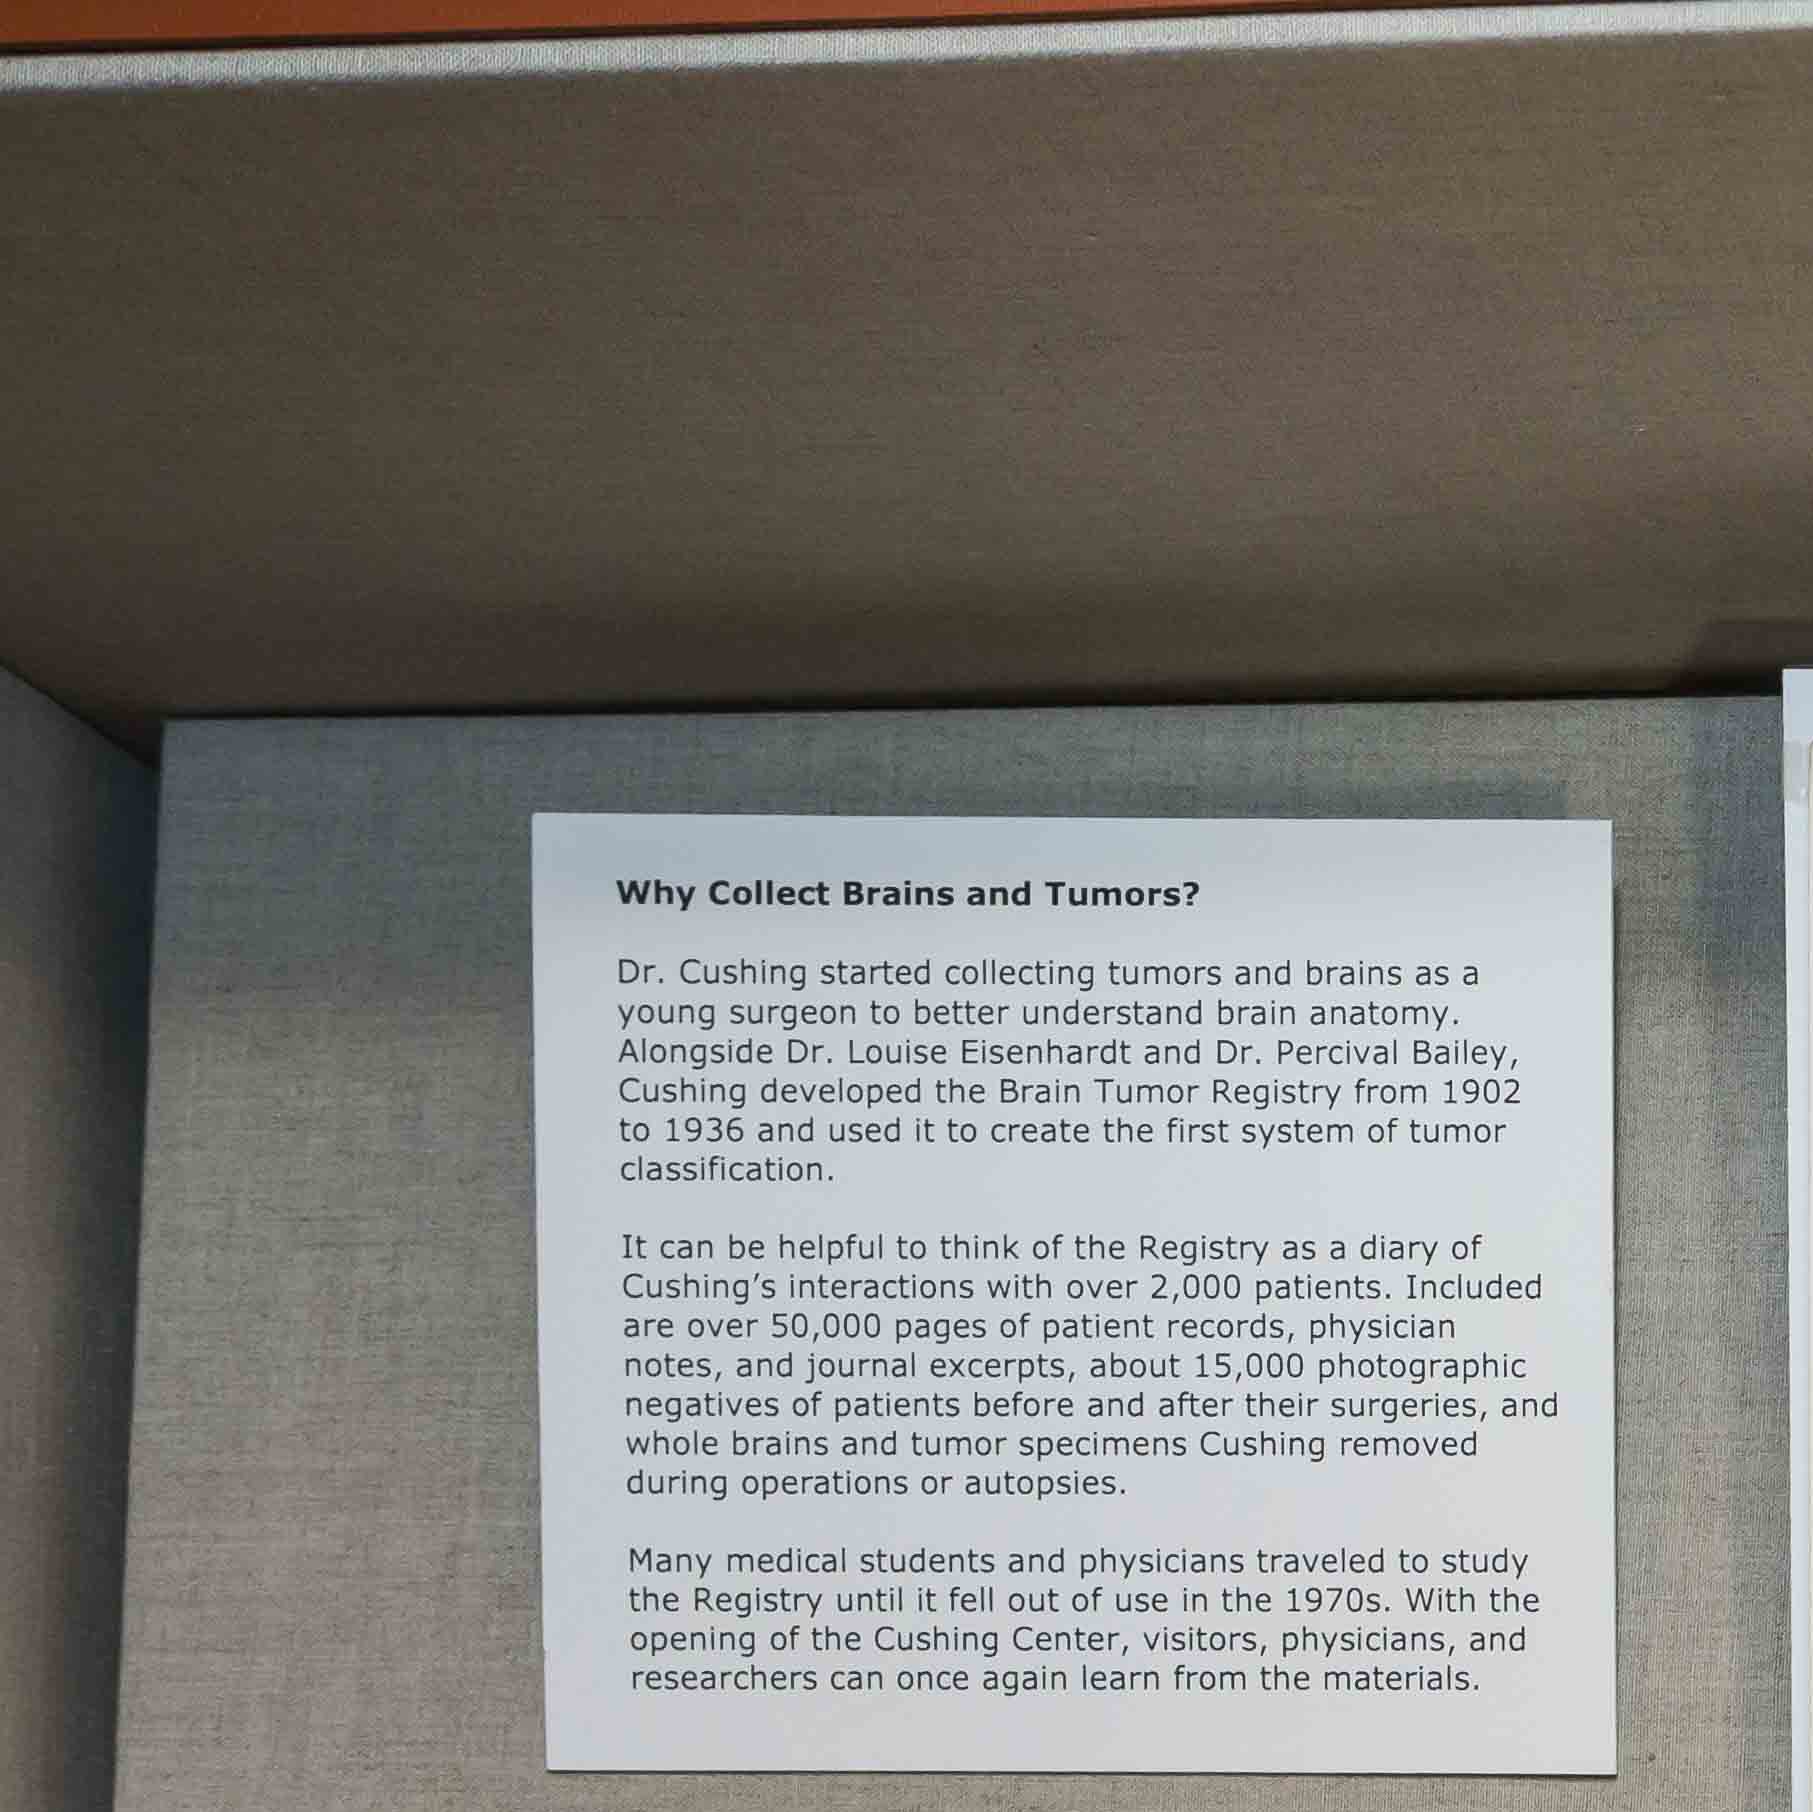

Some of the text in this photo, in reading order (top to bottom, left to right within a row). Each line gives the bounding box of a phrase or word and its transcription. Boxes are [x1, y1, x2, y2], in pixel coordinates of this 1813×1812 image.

[615, 878, 1201, 912] Why Collect Brains and Tumors?
[617, 957, 1479, 993] Dr. Cushing started collecting tumors and brains as a
[616, 997, 1459, 1033] young surgeon to better understand brain anatomy.
[617, 1037, 1518, 1072] Alongside Dr. Louise Eisenhardt and Dr. Percival Bailey,
[620, 1154, 834, 1183] classification.
[629, 1624, 1526, 1659] opening of the Cushing Center, visitors, physicians, and
[631, 1663, 1480, 1697] researchers can once again learn from the materials.
